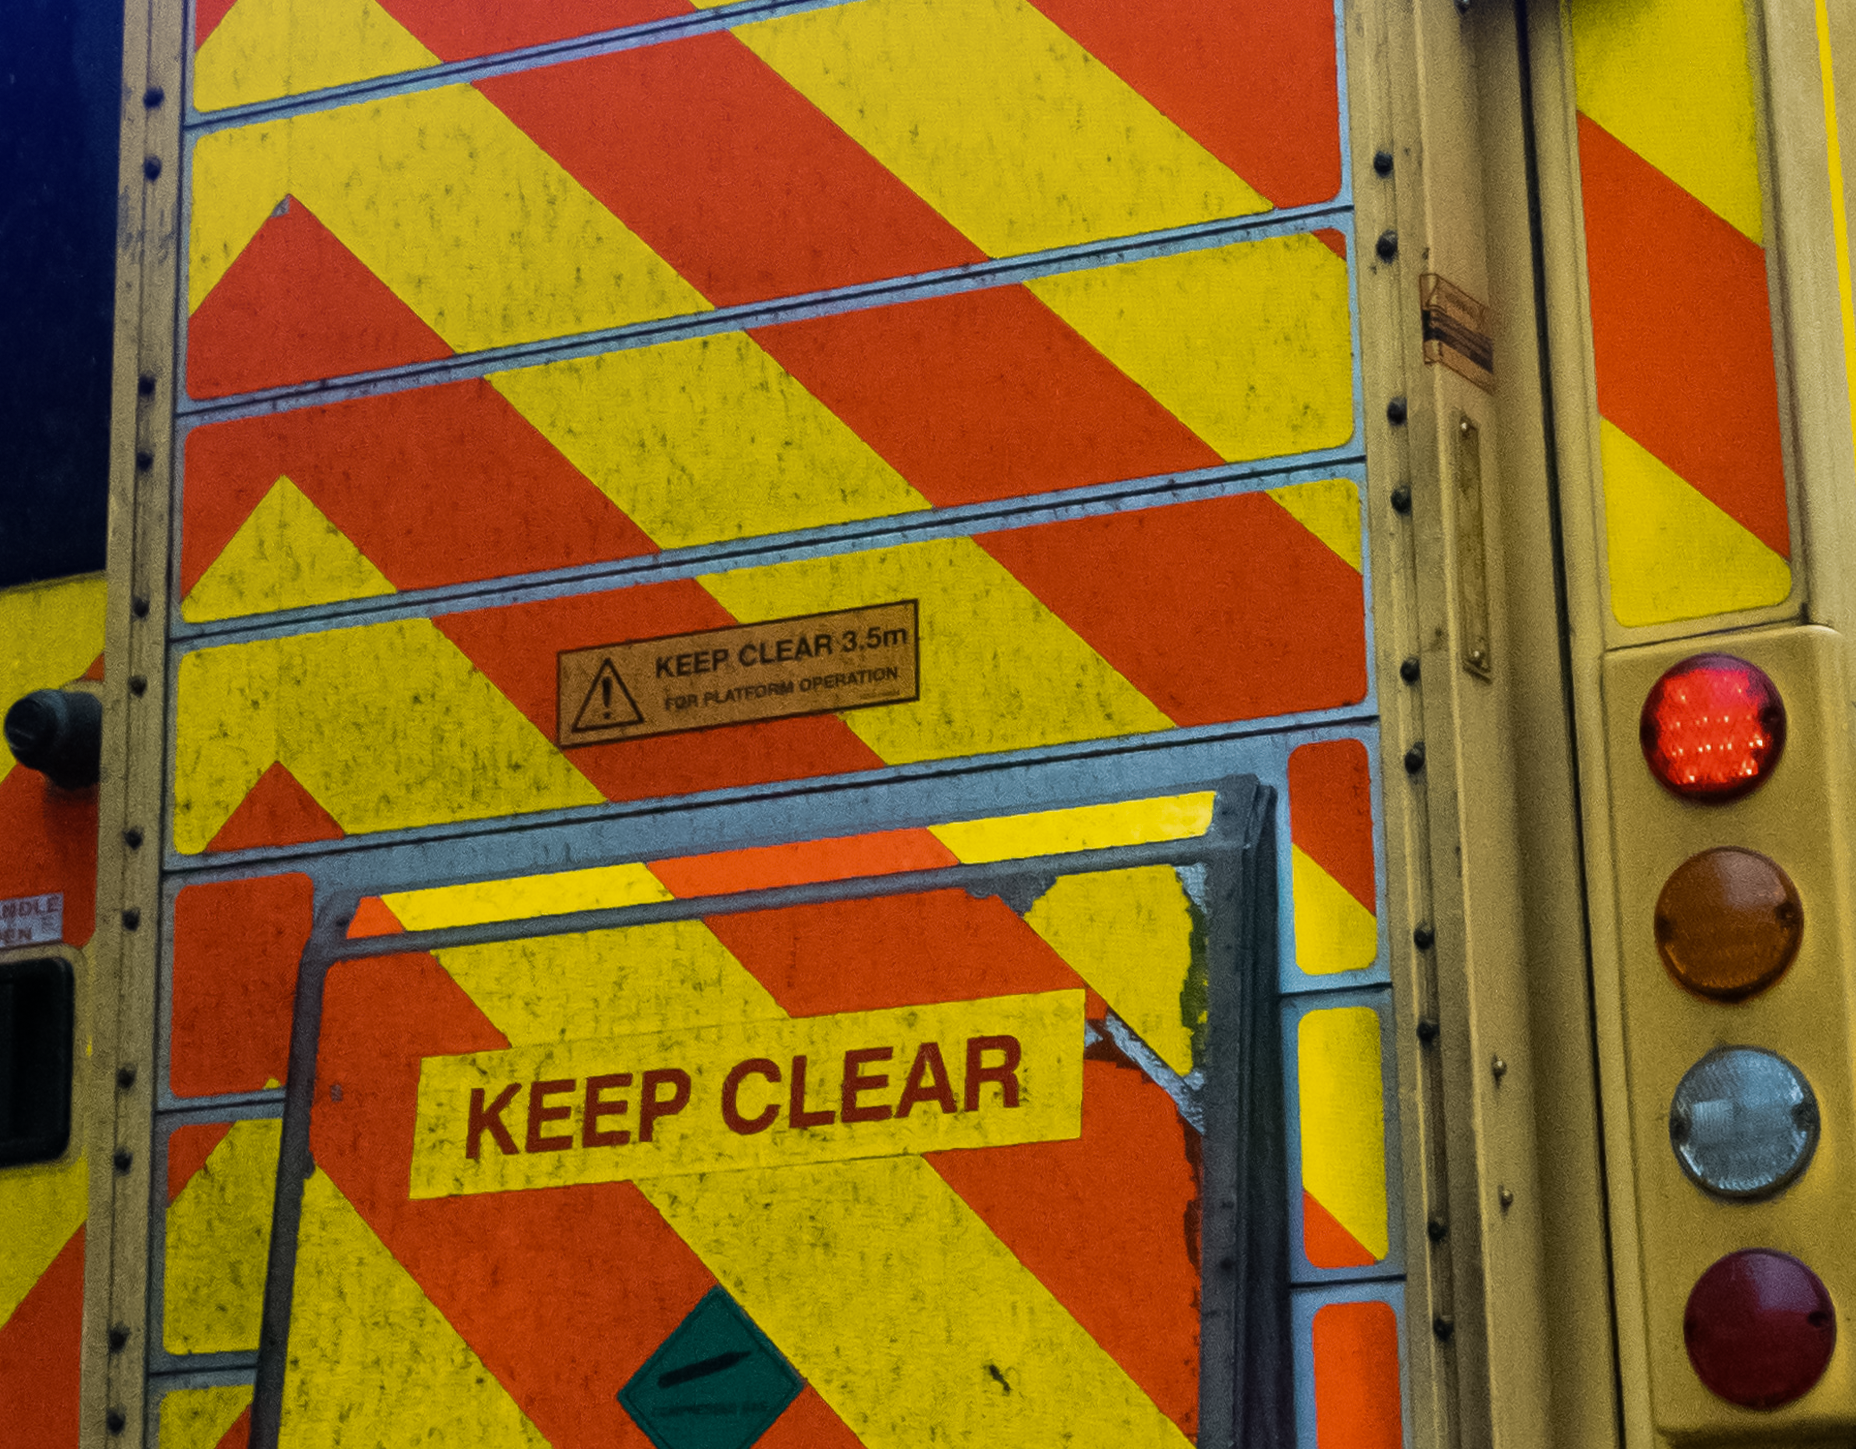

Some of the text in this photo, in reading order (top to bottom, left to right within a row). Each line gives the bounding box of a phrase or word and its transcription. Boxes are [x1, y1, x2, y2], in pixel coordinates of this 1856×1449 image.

[655, 626, 907, 679] KEEP CLEAR 3.5m
[665, 666, 898, 710] FOR PLATFORM OPERATION
[465, 1034, 1025, 1160] KEEP CLEAR
